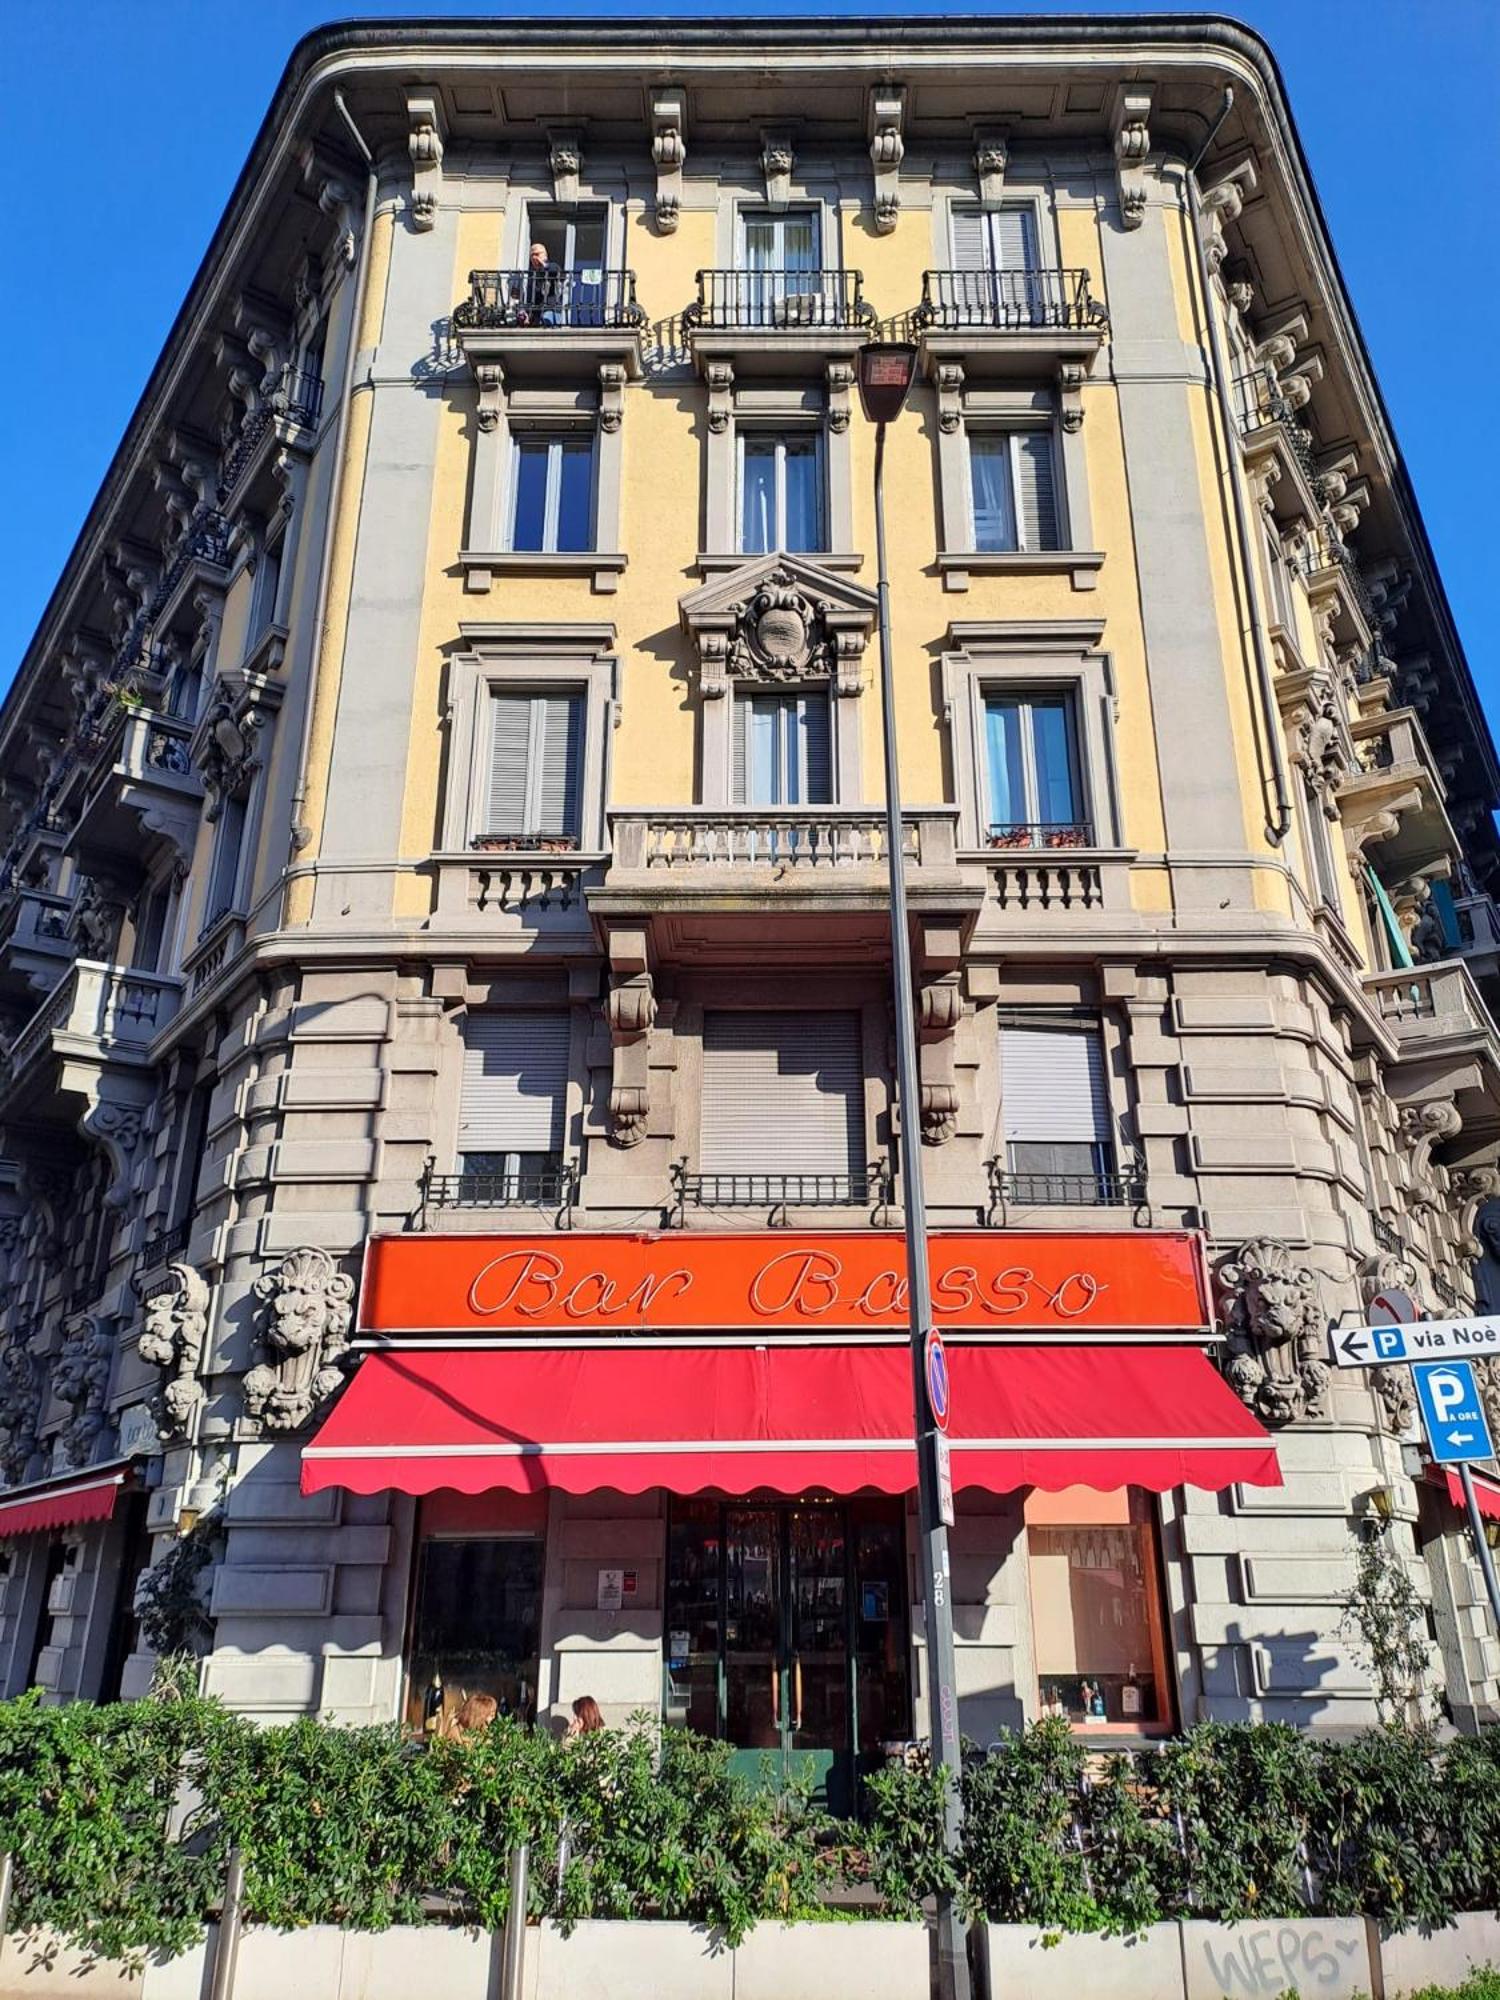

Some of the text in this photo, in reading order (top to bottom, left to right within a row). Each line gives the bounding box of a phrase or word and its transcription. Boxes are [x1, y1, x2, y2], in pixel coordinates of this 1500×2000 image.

[468, 1249, 1109, 1317] Bar Basso
[1379, 1324, 1497, 1355] P via Noè
[1427, 1374, 1465, 1422] P
